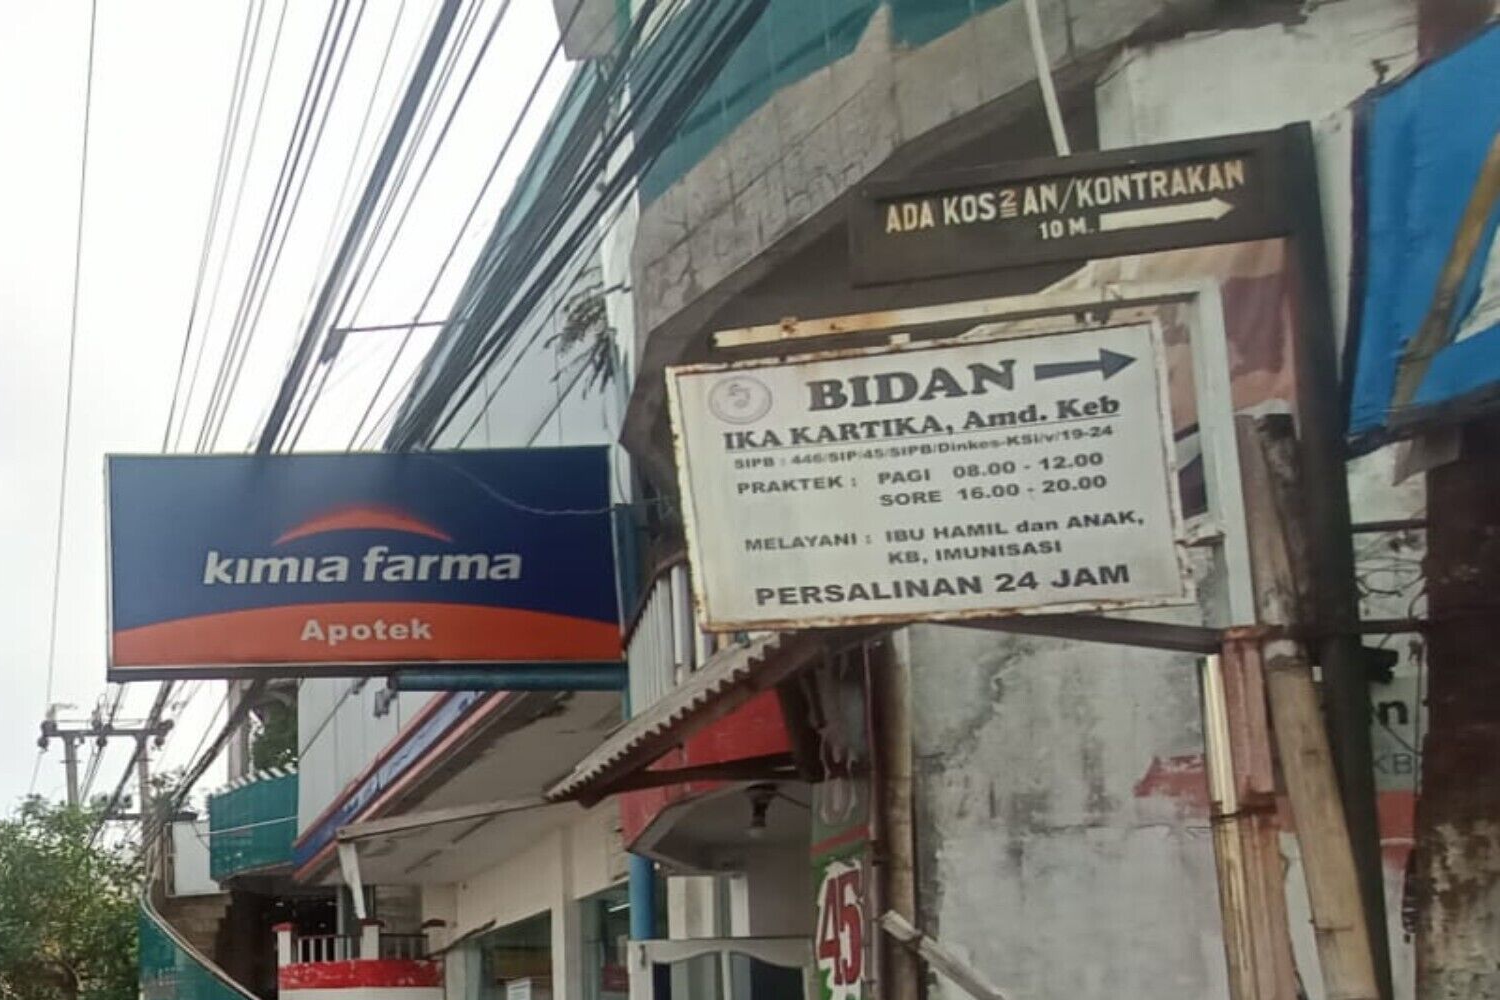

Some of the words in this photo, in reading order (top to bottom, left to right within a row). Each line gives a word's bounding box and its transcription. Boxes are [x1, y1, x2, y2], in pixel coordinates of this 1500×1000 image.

[885, 200, 935, 234] ADA
[1039, 219, 1064, 240] 10
[806, 359, 1017, 412] BIDAN
[723, 429, 782, 450] IKA
[789, 415, 954, 446] KARTIKA,
[962, 404, 1048, 430] Amd.
[1056, 396, 1121, 420] Keb
[737, 475, 843, 495] PRAKTEK
[877, 468, 931, 485] PAGI
[953, 460, 1016, 479] 08.00
[1039, 452, 1104, 471] 12.00
[880, 490, 943, 507] SORE
[957, 483, 1020, 501] 16.00
[1042, 475, 1107, 494] 20.00
[745, 532, 858, 551] MELAYANI
[885, 528, 925, 543] IBU
[933, 522, 1009, 540] HAMIL
[1016, 519, 1059, 534] dan
[1066, 510, 1145, 529] ANAK,
[203, 550, 350, 586] kimia
[362, 545, 522, 582] farma
[887, 551, 929, 565] KB,
[935, 539, 1063, 562] IMUNISASI
[755, 575, 983, 606] PERSALINAN
[994, 571, 1039, 593] 24
[1051, 563, 1130, 589] JAM
[300, 618, 433, 646] Apotek
